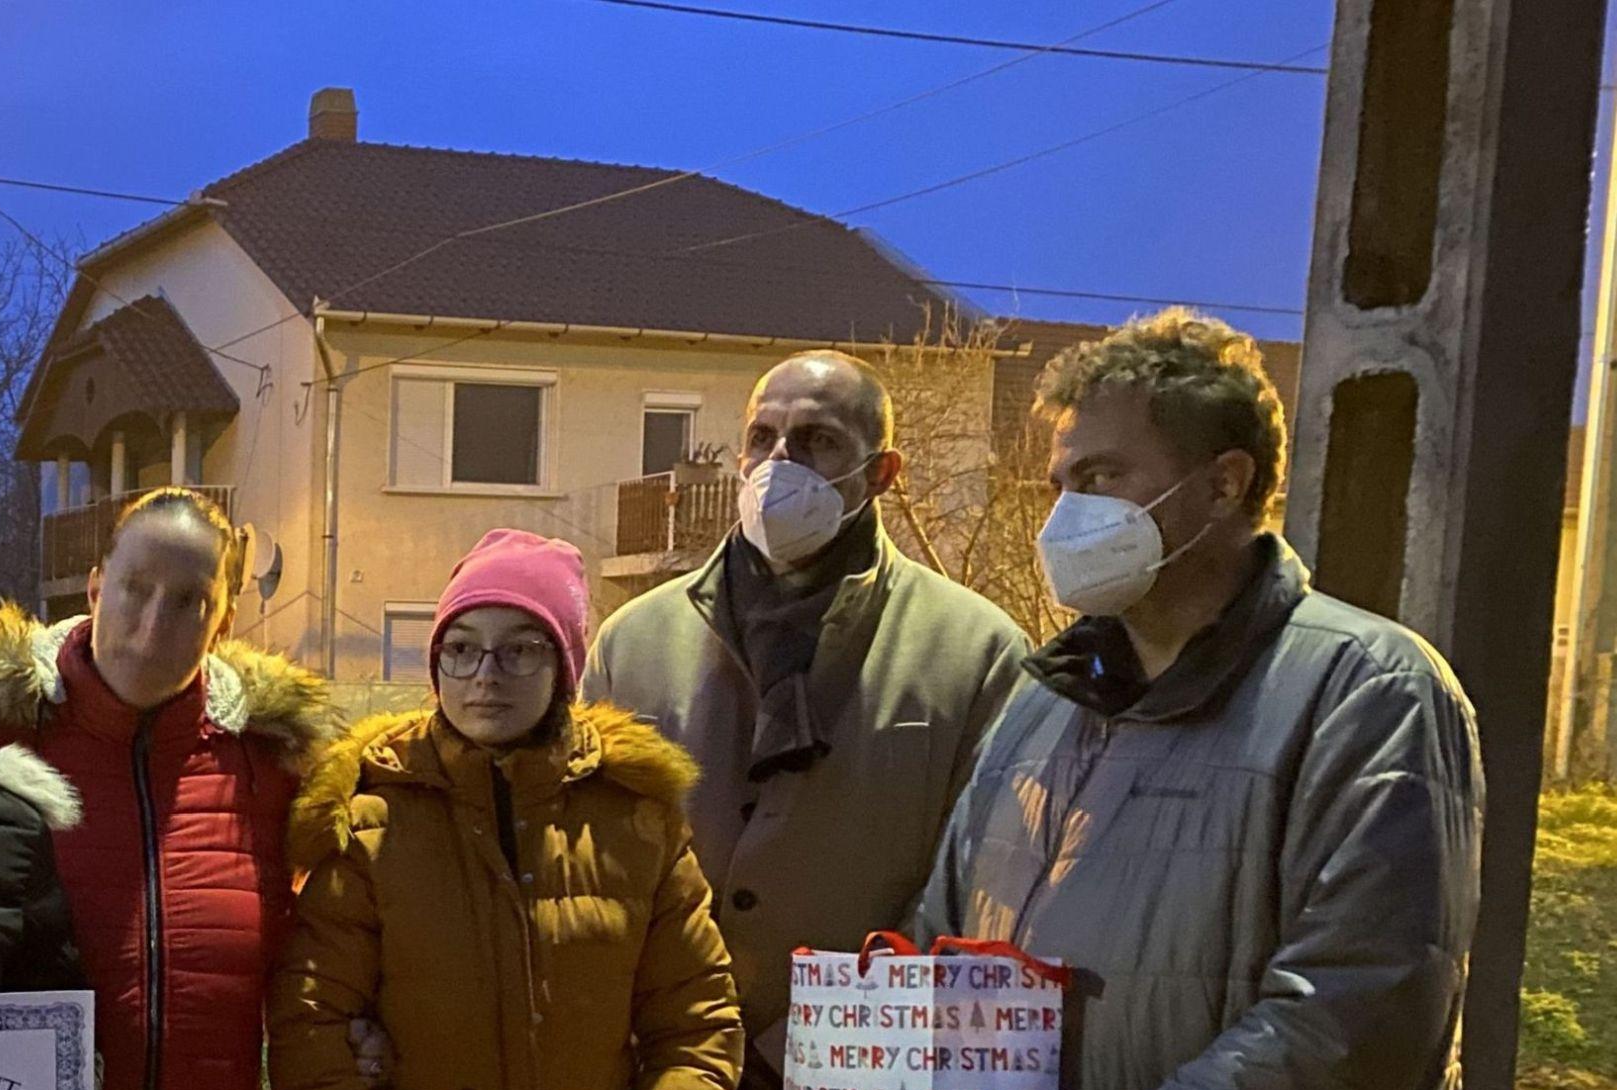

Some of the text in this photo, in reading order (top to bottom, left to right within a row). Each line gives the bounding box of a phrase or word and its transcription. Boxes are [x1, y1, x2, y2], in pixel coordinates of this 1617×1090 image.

[888, 964, 962, 989] MERRY
[829, 1004, 960, 1030] CHRISTMAS
[830, 1045, 900, 1070] MERRY
[906, 1047, 1040, 1072] CHRISTMAS
